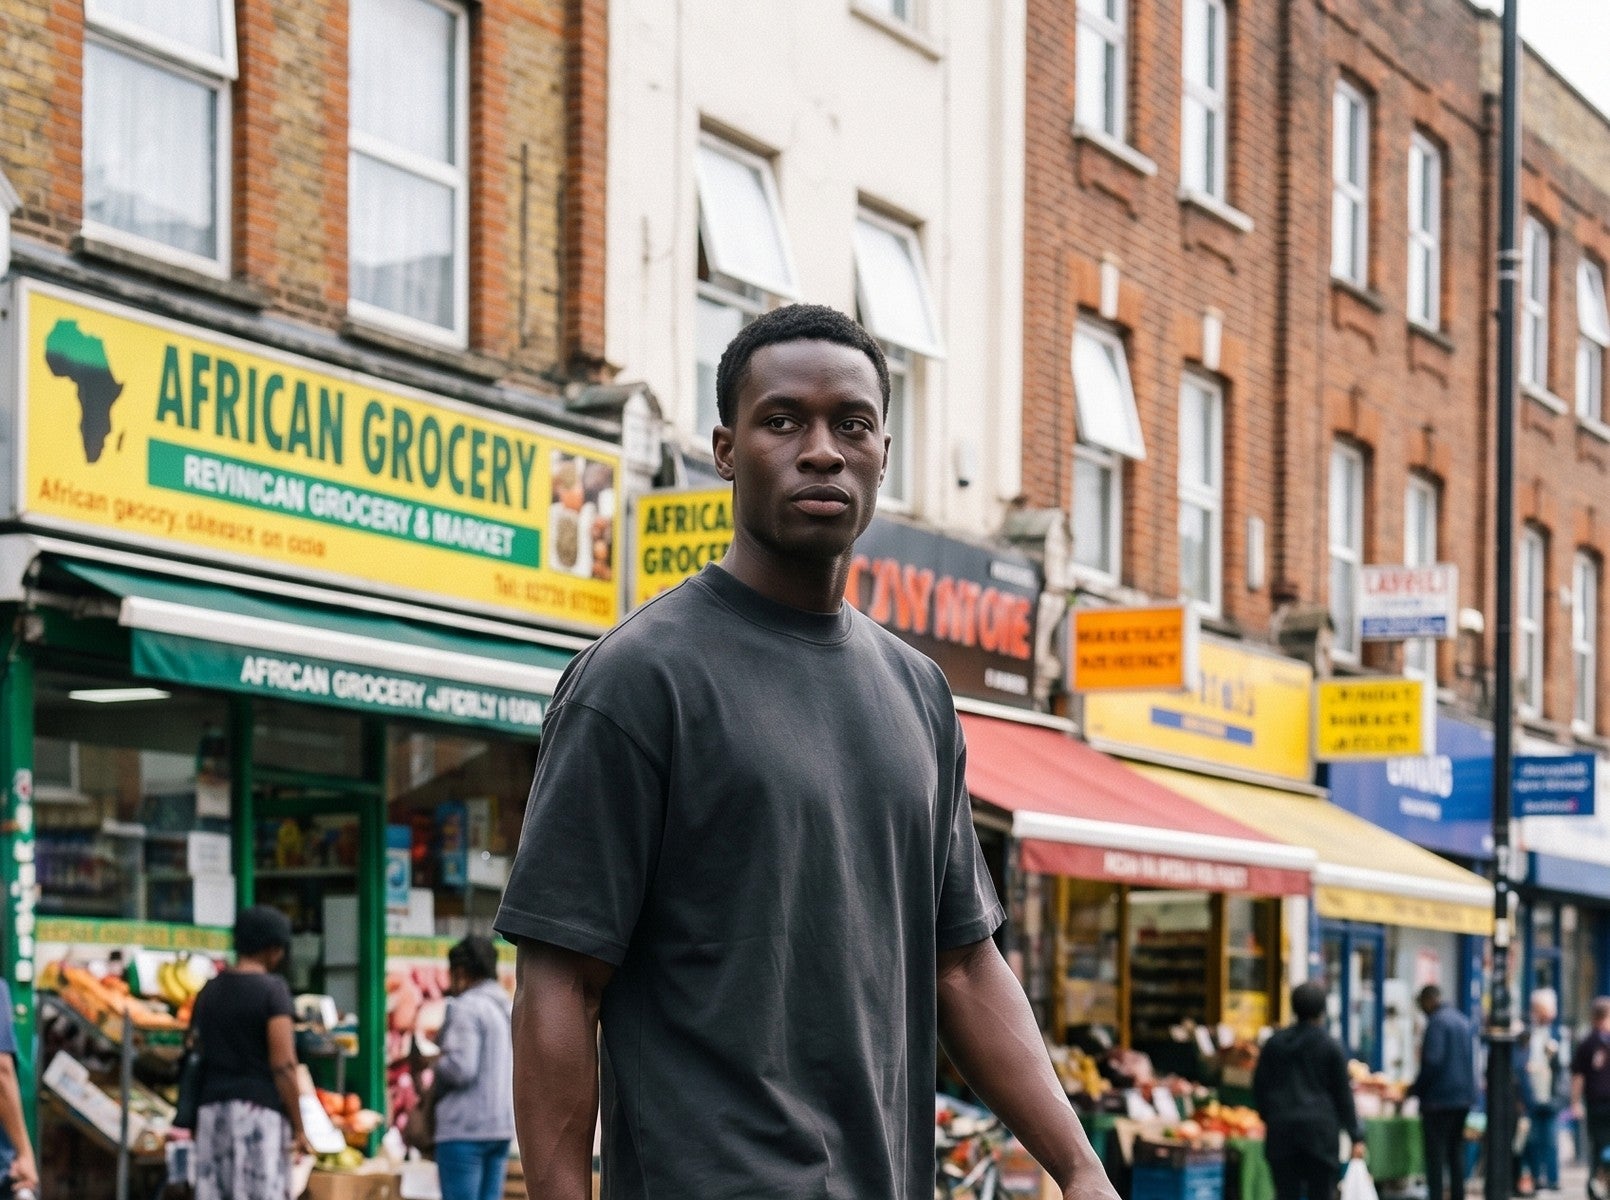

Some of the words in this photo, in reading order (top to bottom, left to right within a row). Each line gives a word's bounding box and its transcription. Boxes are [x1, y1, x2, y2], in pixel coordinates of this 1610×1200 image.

[156, 344, 344, 465] AFRICAN
[362, 400, 537, 510] GROCERY
[38, 477, 109, 513] African
[183, 453, 306, 513] REVINICAN
[308, 482, 413, 536] GROCERY
[413, 506, 431, 540] &
[432, 511, 517, 558] MARKET
[643, 502, 734, 535] AFRICA
[240, 654, 330, 696] AFRICAN
[332, 669, 427, 711] GROCERY
